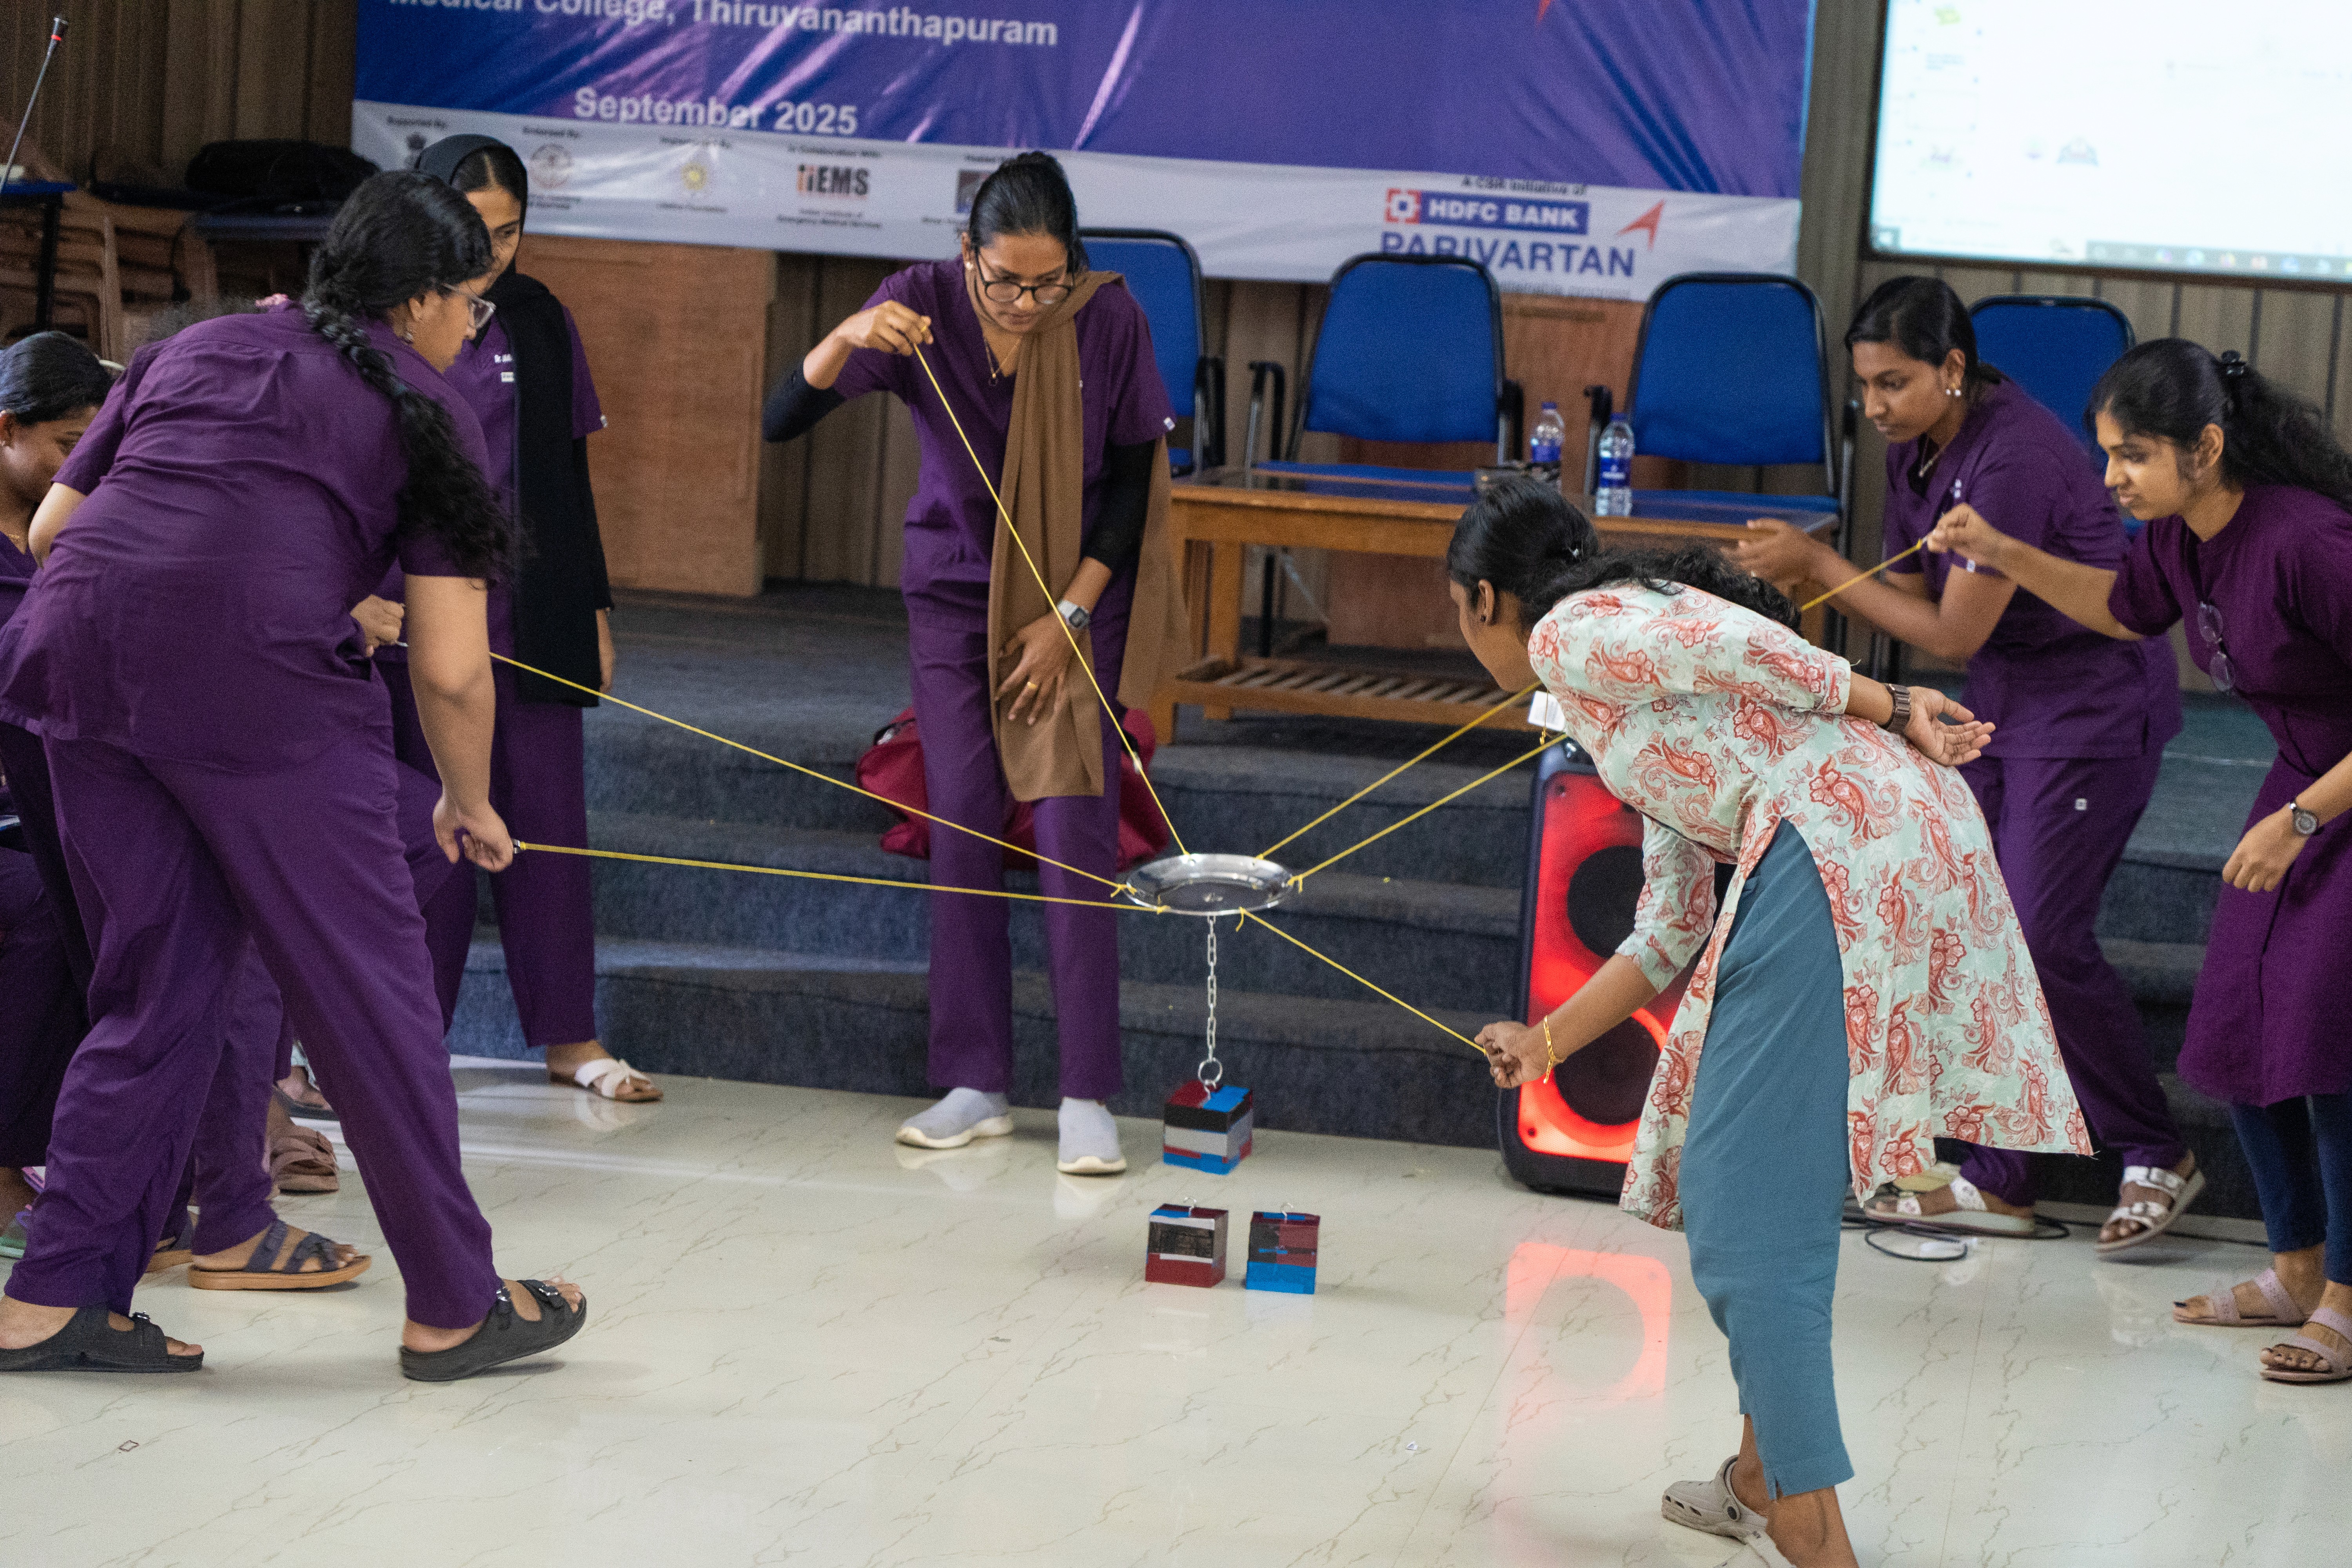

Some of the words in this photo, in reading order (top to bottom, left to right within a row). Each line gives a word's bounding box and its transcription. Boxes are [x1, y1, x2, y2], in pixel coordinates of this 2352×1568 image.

[692, 0, 1058, 46] Thiruvananthapuram
[575, 86, 761, 128] September
[775, 102, 858, 134] 2025
[1428, 199, 1499, 222] HDFC
[1504, 203, 1578, 227] BANK
[1381, 232, 1635, 277] PARIVARTAN
